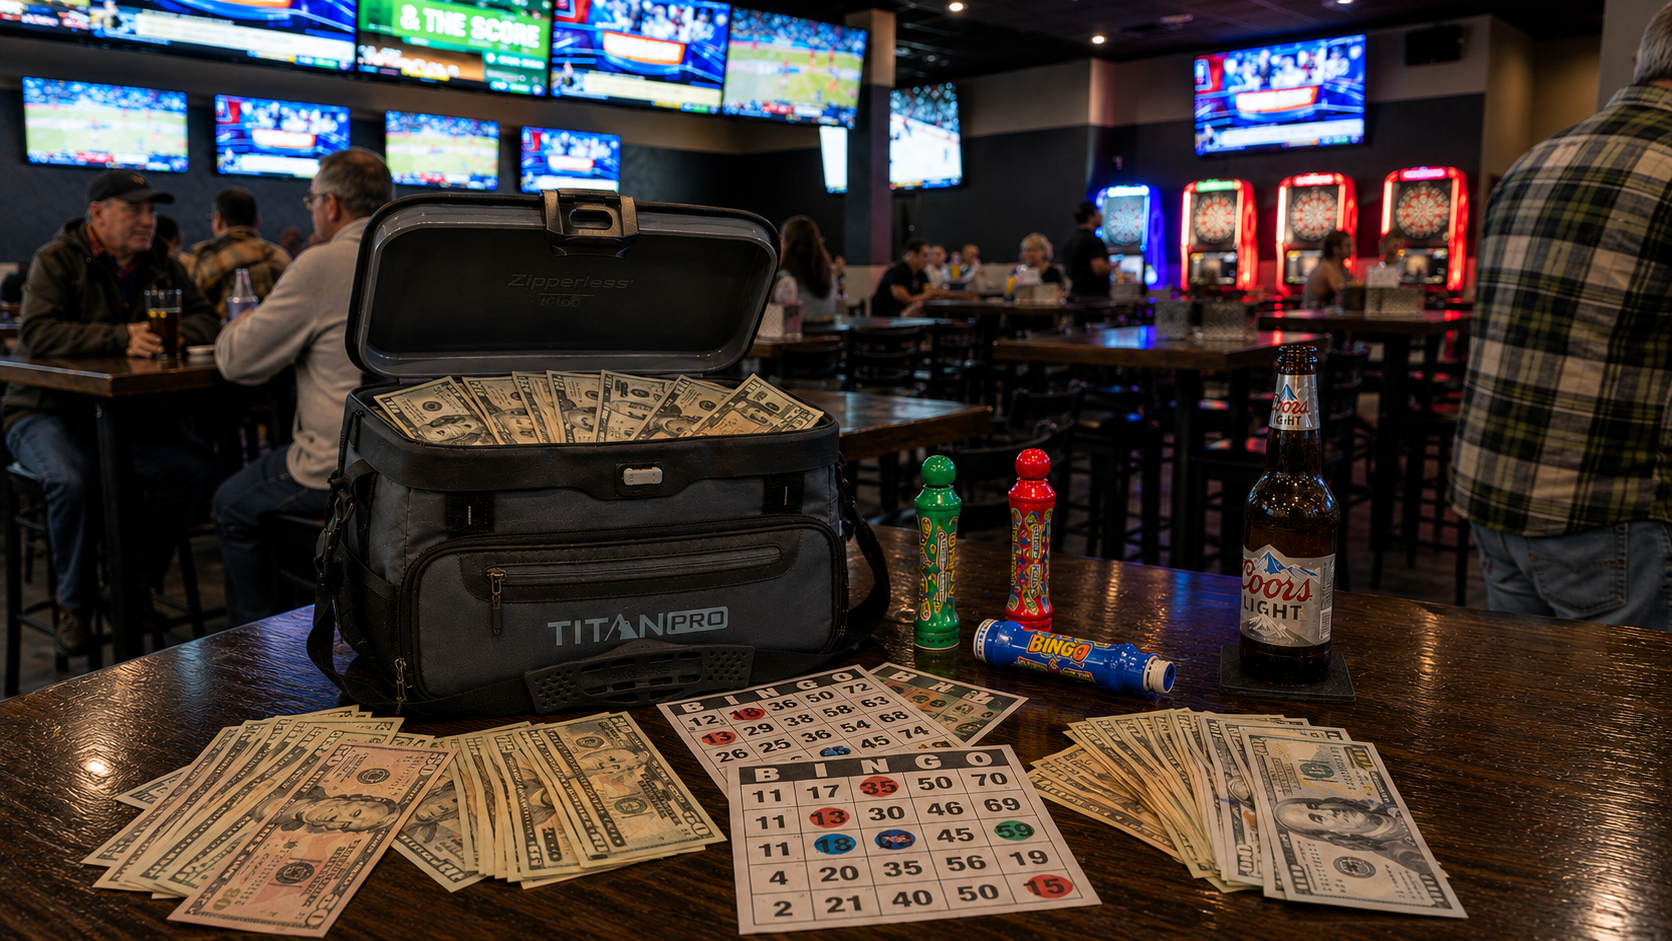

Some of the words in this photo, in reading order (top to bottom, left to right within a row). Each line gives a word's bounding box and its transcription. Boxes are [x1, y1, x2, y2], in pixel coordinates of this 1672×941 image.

[400, 4, 421, 31] &
[422, 7, 466, 38] THE
[470, 15, 541, 49] SCORE
[507, 273, 629, 291] Zipperless
[1242, 558, 1311, 603] Coors
[1244, 595, 1302, 621] LIGHT
[1028, 634, 1091, 662] BINGO
[689, 714, 719, 728] 12
[768, 699, 798, 712] 36
[805, 691, 835, 703] 50
[842, 683, 873, 694] 72
[702, 731, 732, 744] 13
[743, 723, 775, 736] 29
[783, 714, 815, 727] 38
[861, 696, 890, 708] 63
[715, 748, 749, 763] 26
[758, 738, 791, 753] 25
[801, 729, 832, 743] 36
[840, 720, 872, 733] 54
[861, 735, 891, 750] 45
[898, 725, 930, 739] 74
[752, 789, 782, 803] 11
[806, 784, 840, 799] 17
[860, 780, 896, 795] 35
[918, 776, 953, 791] 50
[971, 772, 1008, 787] 70
[755, 815, 785, 830] 11
[811, 811, 846, 826] 13
[868, 805, 905, 821] 30
[927, 801, 964, 816] 46
[984, 798, 1021, 812] 69
[758, 842, 790, 857] 11
[816, 837, 852, 853] 18
[937, 827, 974, 843] 45
[997, 823, 1034, 838] 59
[769, 870, 789, 885] 4
[819, 865, 859, 882] 20
[883, 860, 923, 877] 35
[945, 855, 987, 872] 56
[1009, 850, 1049, 866] 19
[773, 900, 793, 917] 2
[825, 895, 862, 913] 21
[892, 890, 933, 907] 40
[957, 884, 999, 902] 50
[1023, 878, 1065, 896] 15
